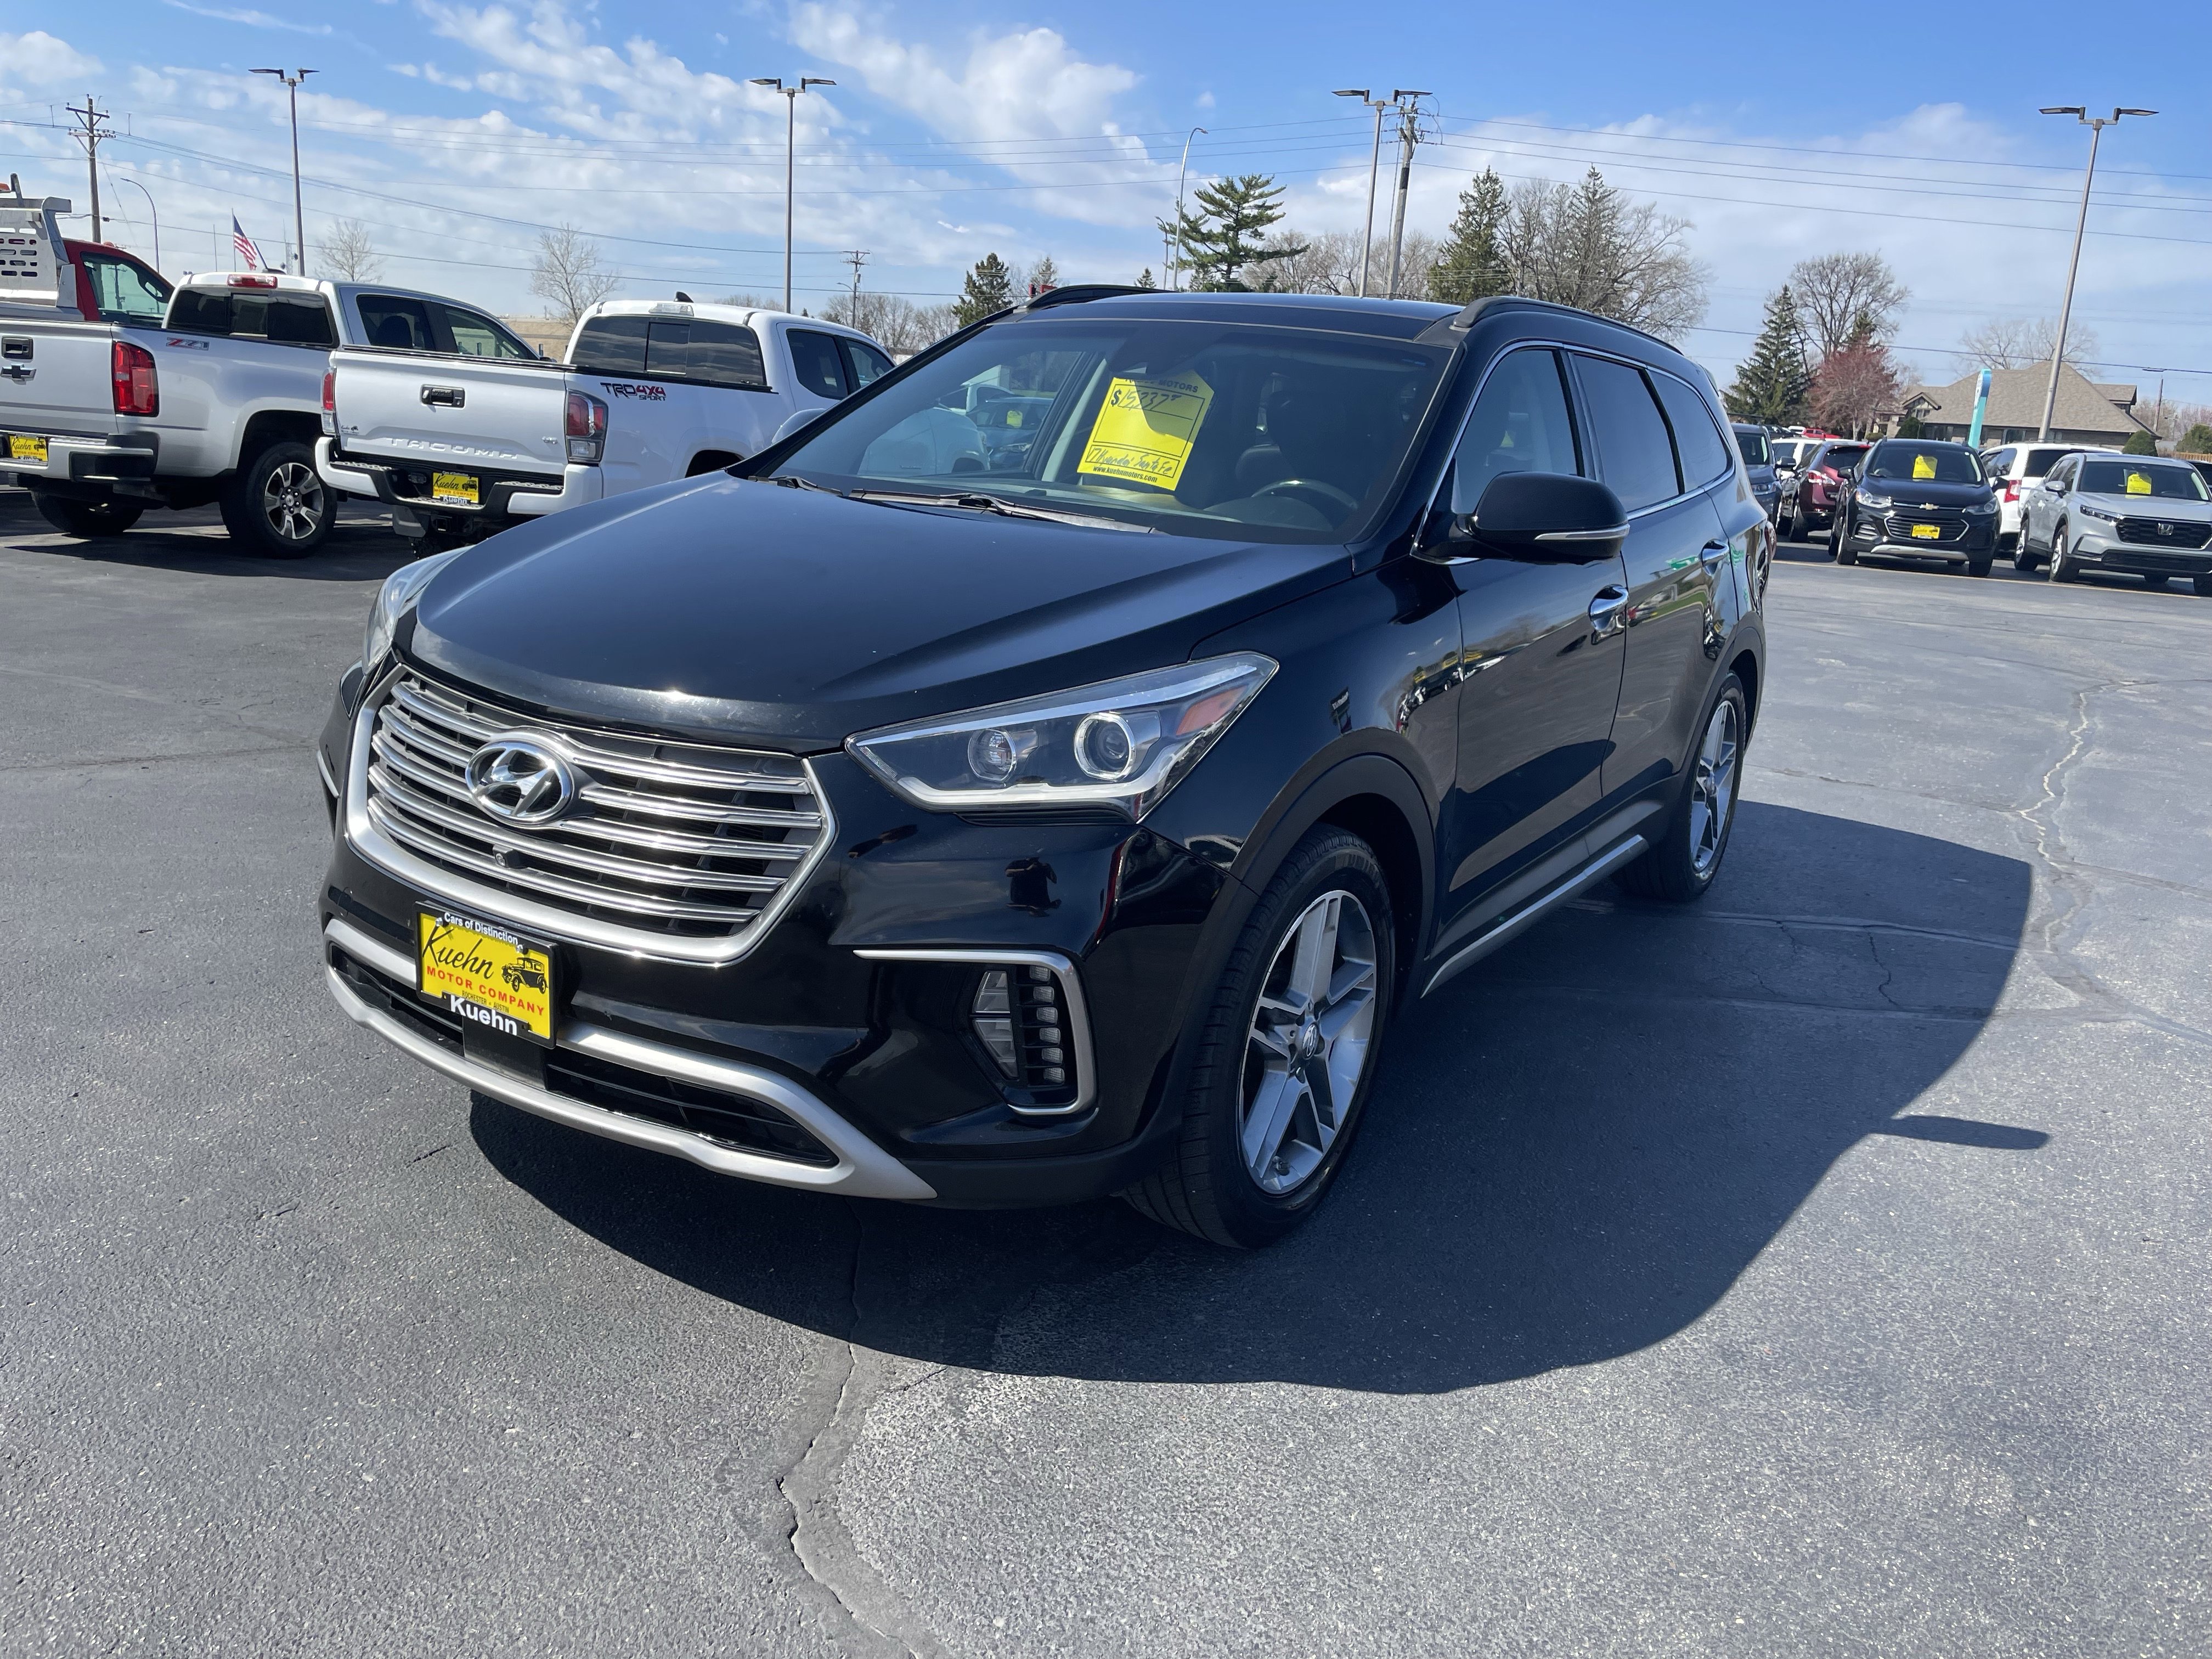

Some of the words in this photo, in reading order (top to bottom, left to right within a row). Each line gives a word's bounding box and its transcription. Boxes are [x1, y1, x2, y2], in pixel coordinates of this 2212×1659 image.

[166, 337, 210, 351] Z71
[1158, 379, 1199, 393] MOTORS
[12, 438, 31, 450] Kuehn
[386, 437, 518, 460] TACOMA
[433, 475, 459, 490] Kuehn
[1092, 466, 1158, 483] www.kuehnmotors.com
[444, 912, 463, 927] Cars
[465, 919, 473, 930] of
[475, 922, 518, 945] Distinction
[422, 926, 494, 979] Kuehn
[426, 965, 473, 990] MOTOR
[479, 985, 544, 1015] COMPANY
[462, 990, 487, 1006] ROCHESTER
[493, 1002, 510, 1014] AUSTIN
[450, 994, 518, 1036] Kuehn
